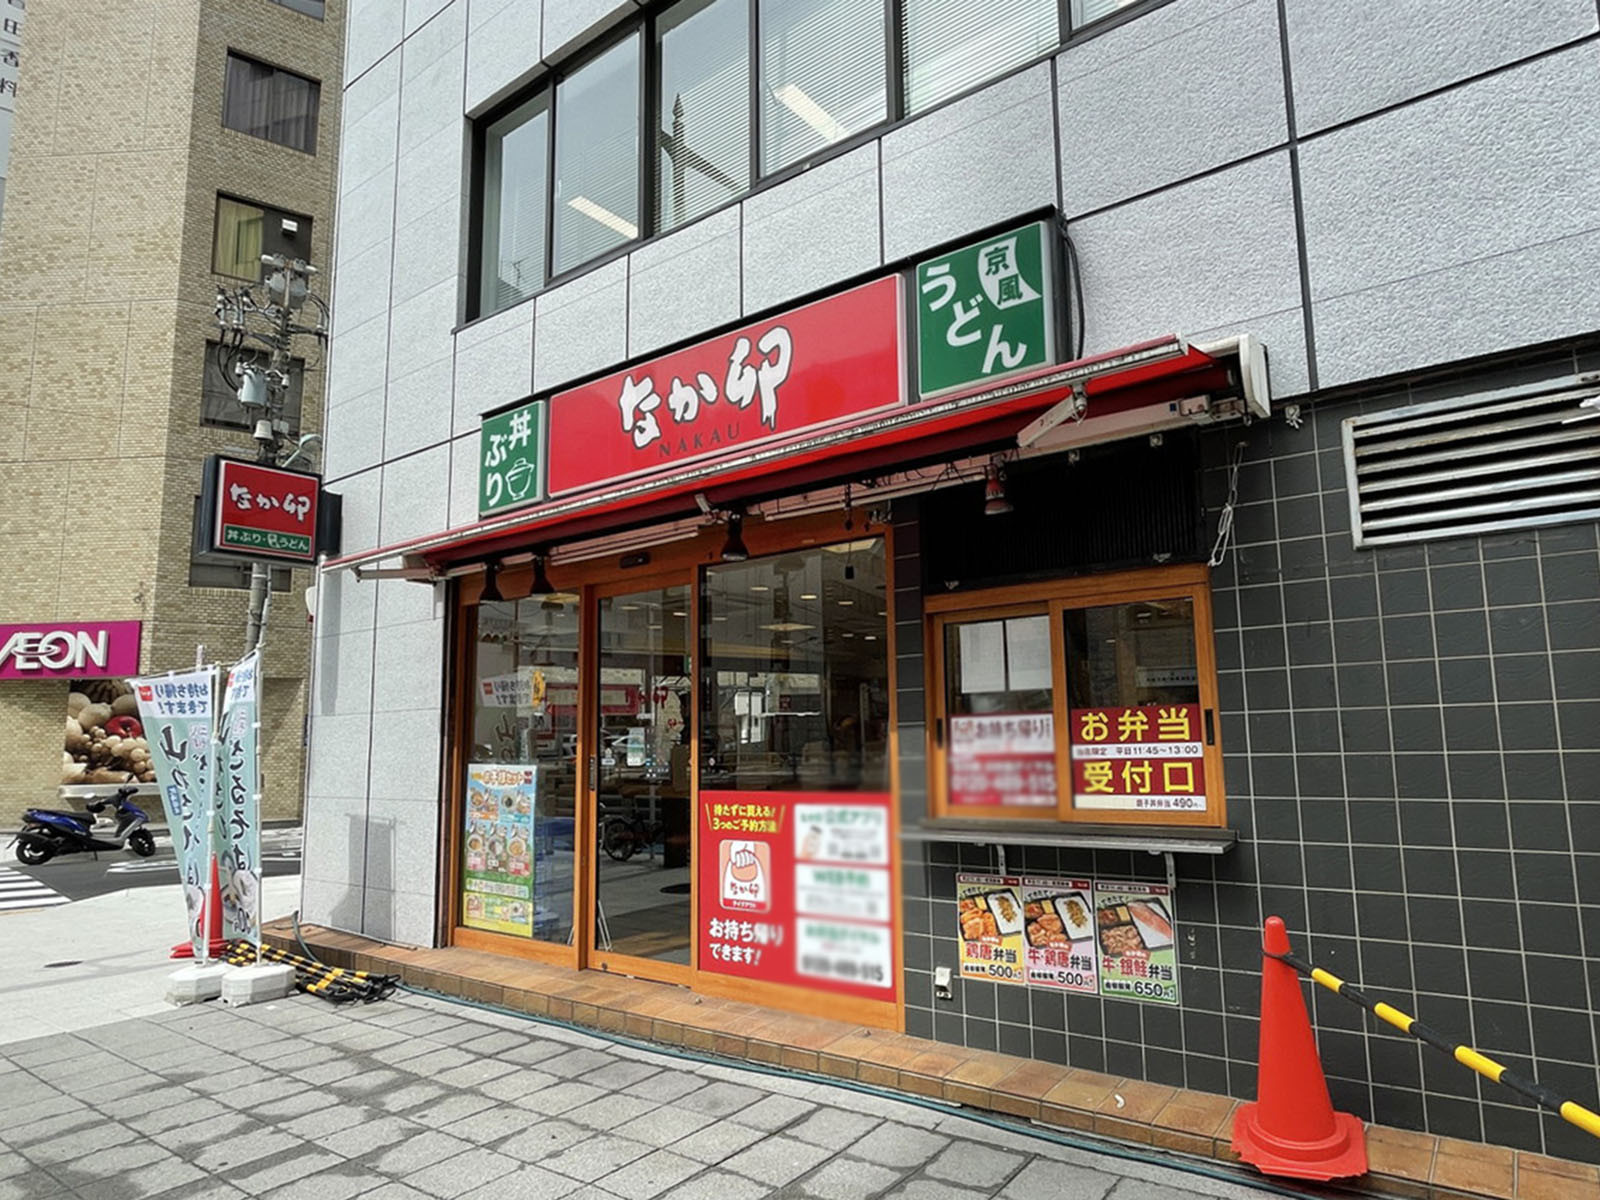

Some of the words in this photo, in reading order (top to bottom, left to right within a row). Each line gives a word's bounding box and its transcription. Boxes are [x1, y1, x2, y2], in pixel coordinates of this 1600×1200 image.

[984, 246, 1023, 306] 京風
[921, 263, 1027, 374] うどん
[619, 325, 793, 448] なか卯
[484, 409, 531, 507] 丼ぶり
[659, 424, 741, 458] NAKAU
[229, 483, 311, 522] なか卯
[1081, 707, 1190, 741] お弁当
[1084, 760, 1194, 793] 受付口
[709, 917, 784, 947] お持ち帰り
[709, 943, 762, 966] できます!
